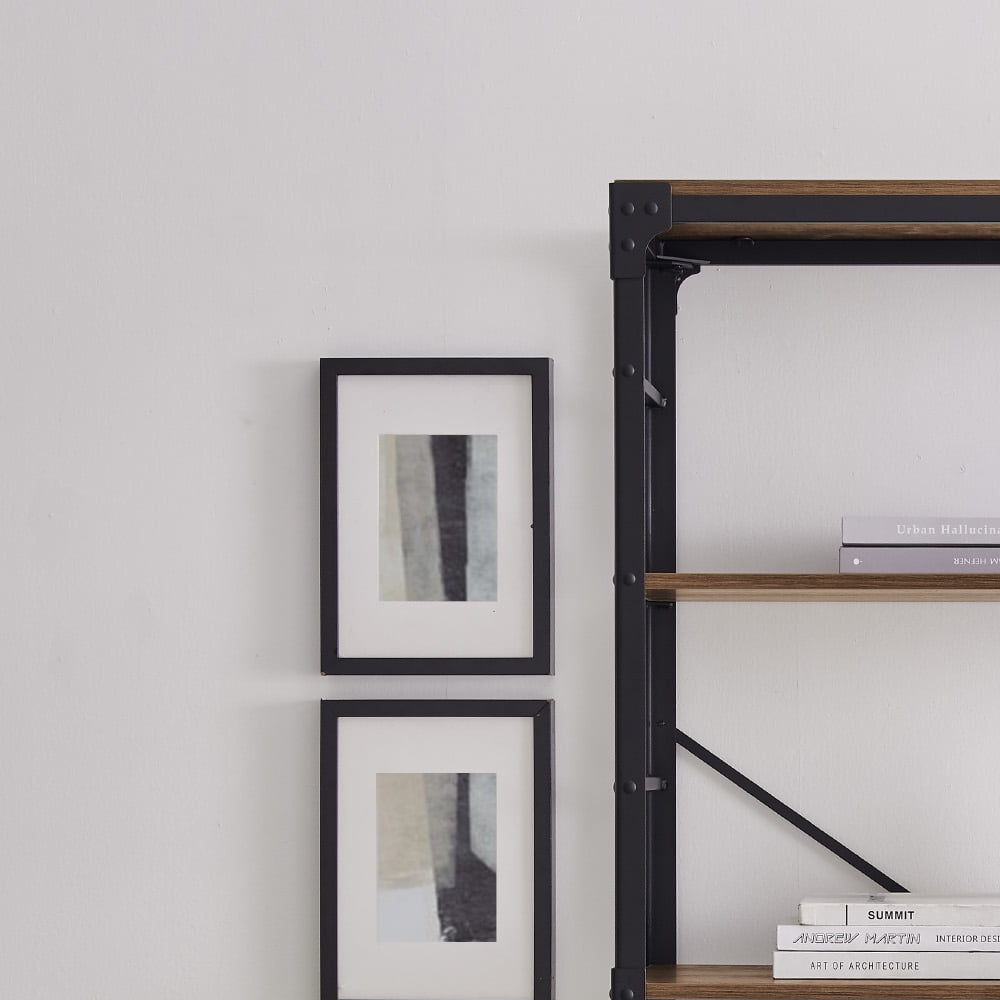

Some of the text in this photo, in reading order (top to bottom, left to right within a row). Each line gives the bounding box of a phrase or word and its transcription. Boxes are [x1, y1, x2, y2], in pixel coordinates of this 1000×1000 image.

[896, 524, 936, 535] Urban
[867, 910, 915, 920] SUMMIT
[792, 932, 921, 945] ANDREW MARTIN
[935, 934, 978, 943] INTERIOR
[810, 961, 919, 971] ART OF ARCHITECTURE
